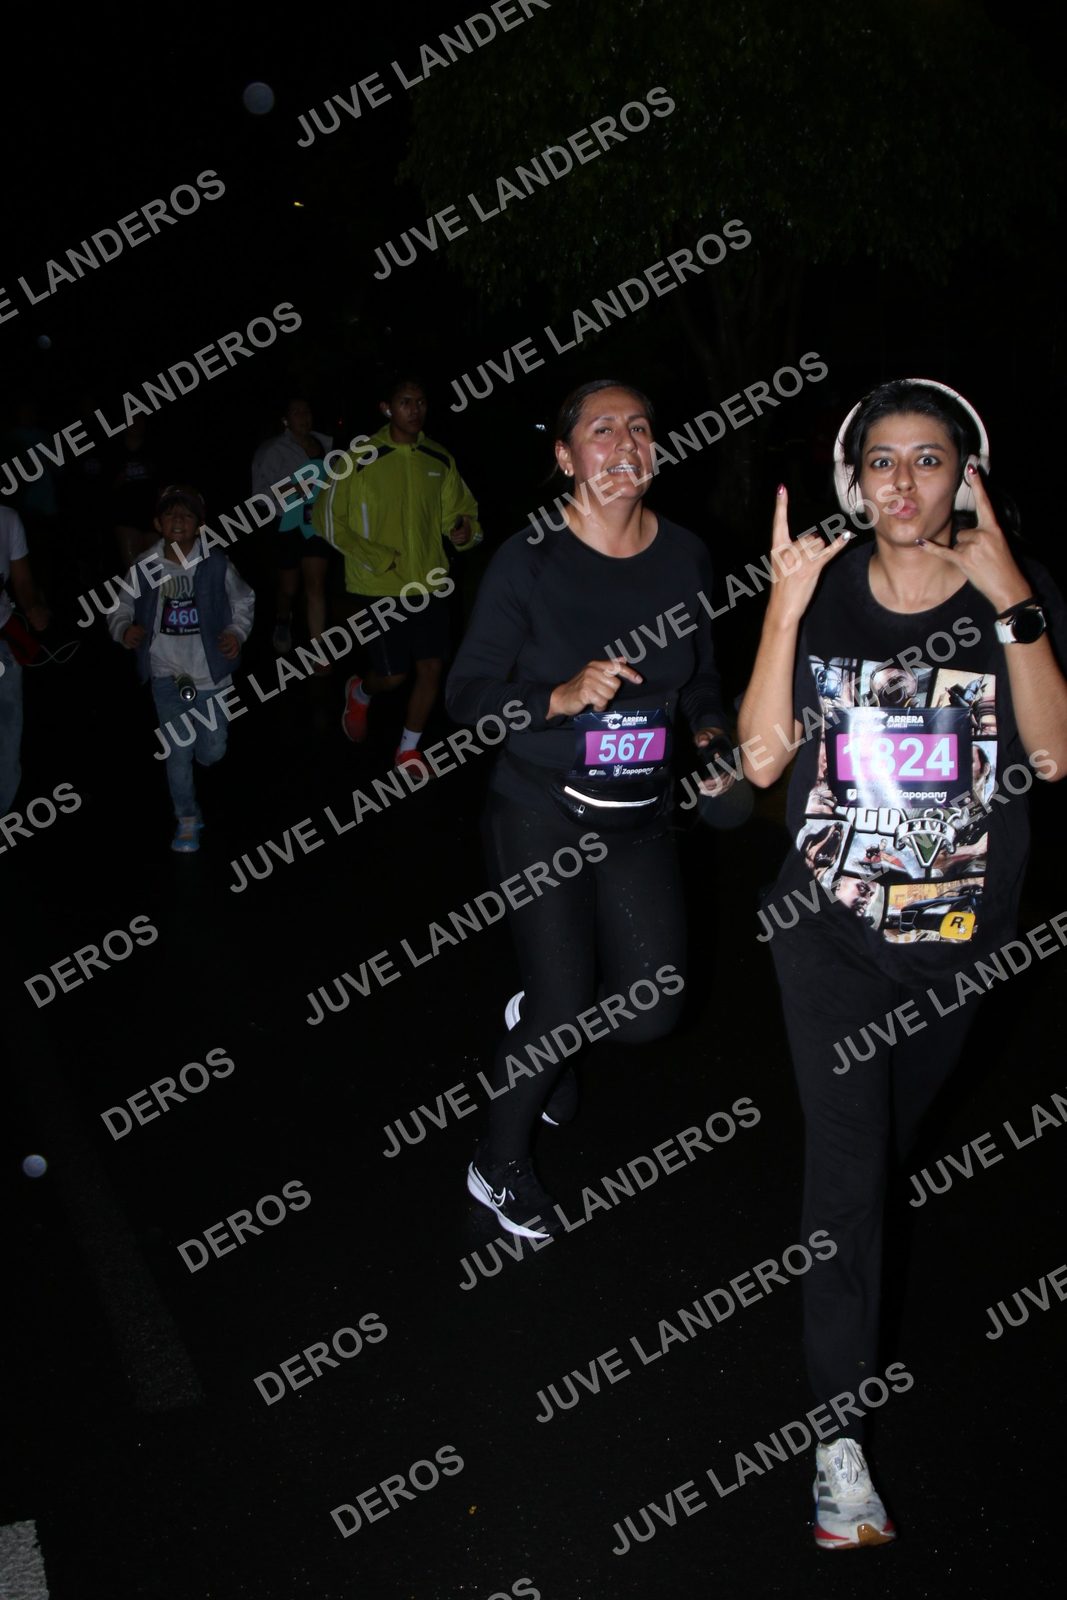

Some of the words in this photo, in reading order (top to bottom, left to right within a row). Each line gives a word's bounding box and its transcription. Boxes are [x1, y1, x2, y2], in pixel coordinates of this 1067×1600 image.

[168, 608, 199, 625] 460
[598, 731, 655, 762] 567
[843, 737, 955, 777] 1824
